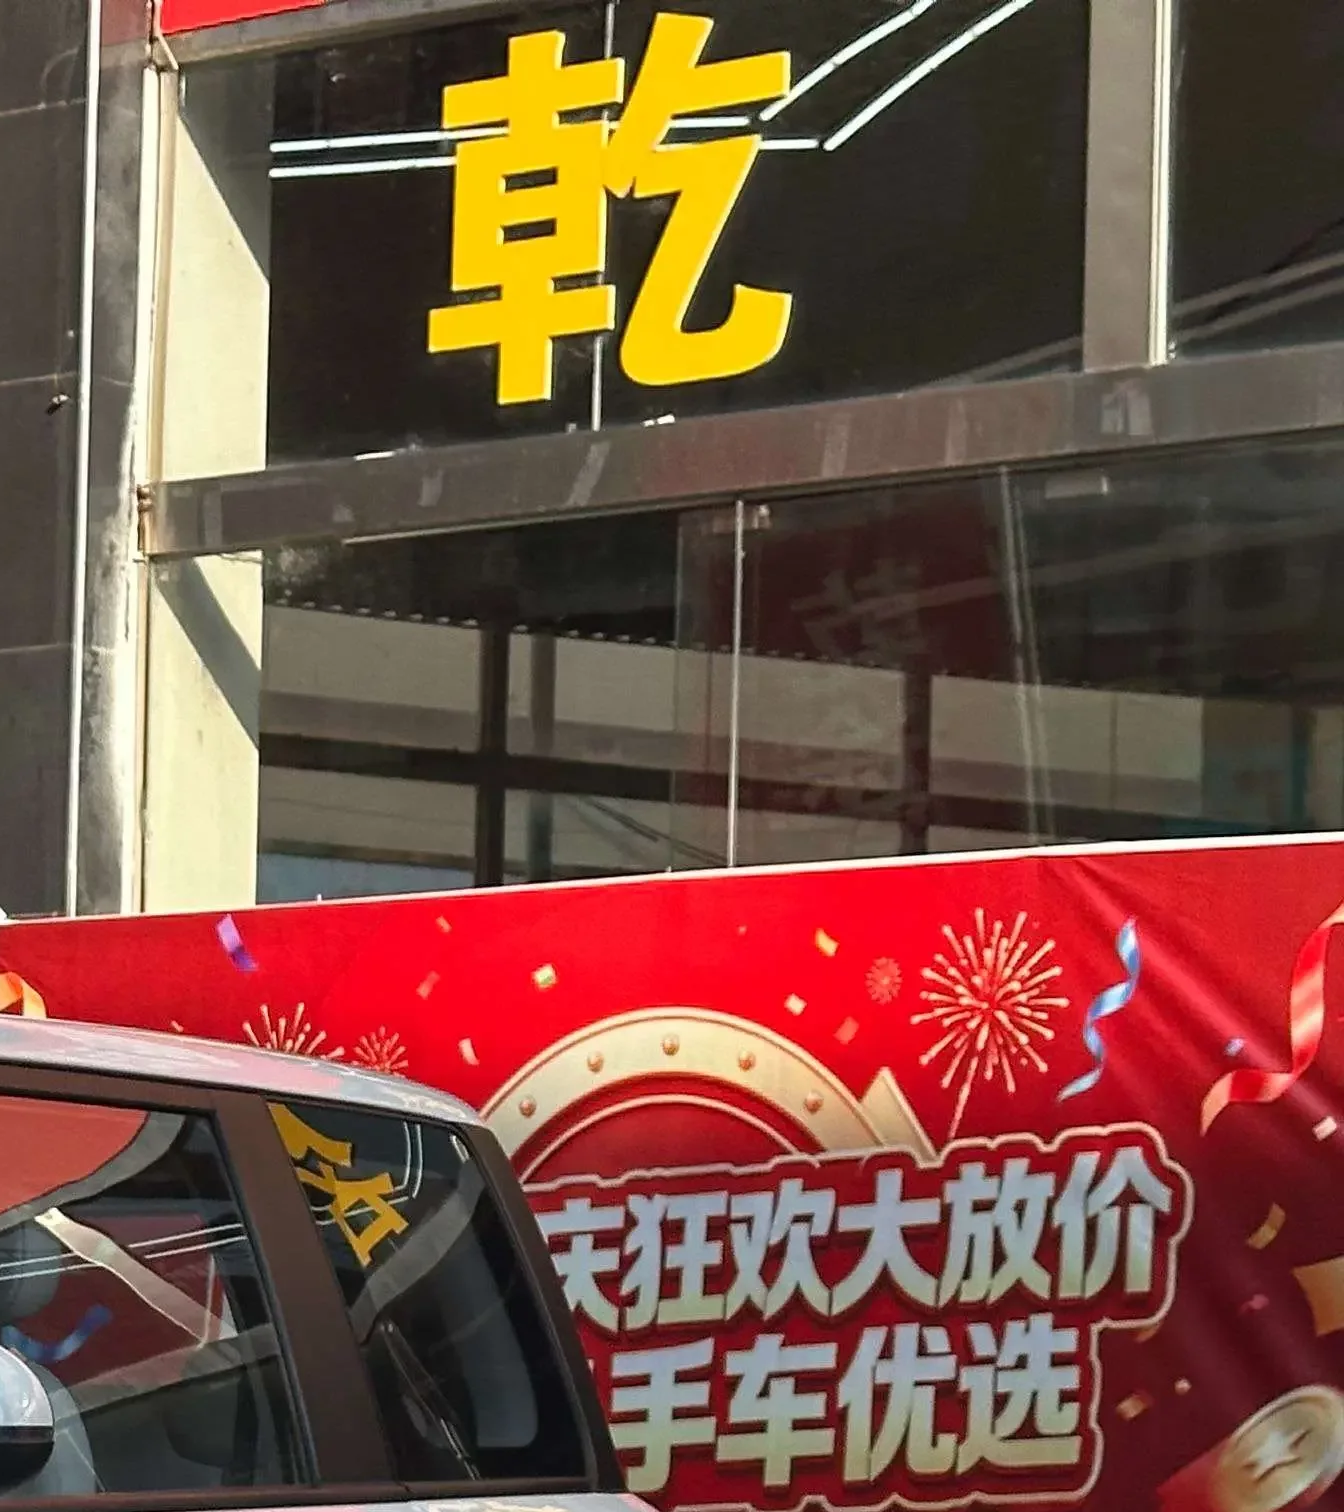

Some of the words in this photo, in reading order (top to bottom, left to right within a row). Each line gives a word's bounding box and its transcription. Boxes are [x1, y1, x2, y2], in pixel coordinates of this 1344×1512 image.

[428, 12, 793, 406] 乾
[533, 1146, 1172, 1333] 庆狂欢大放价
[588, 1312, 1082, 1493] 手车优选
